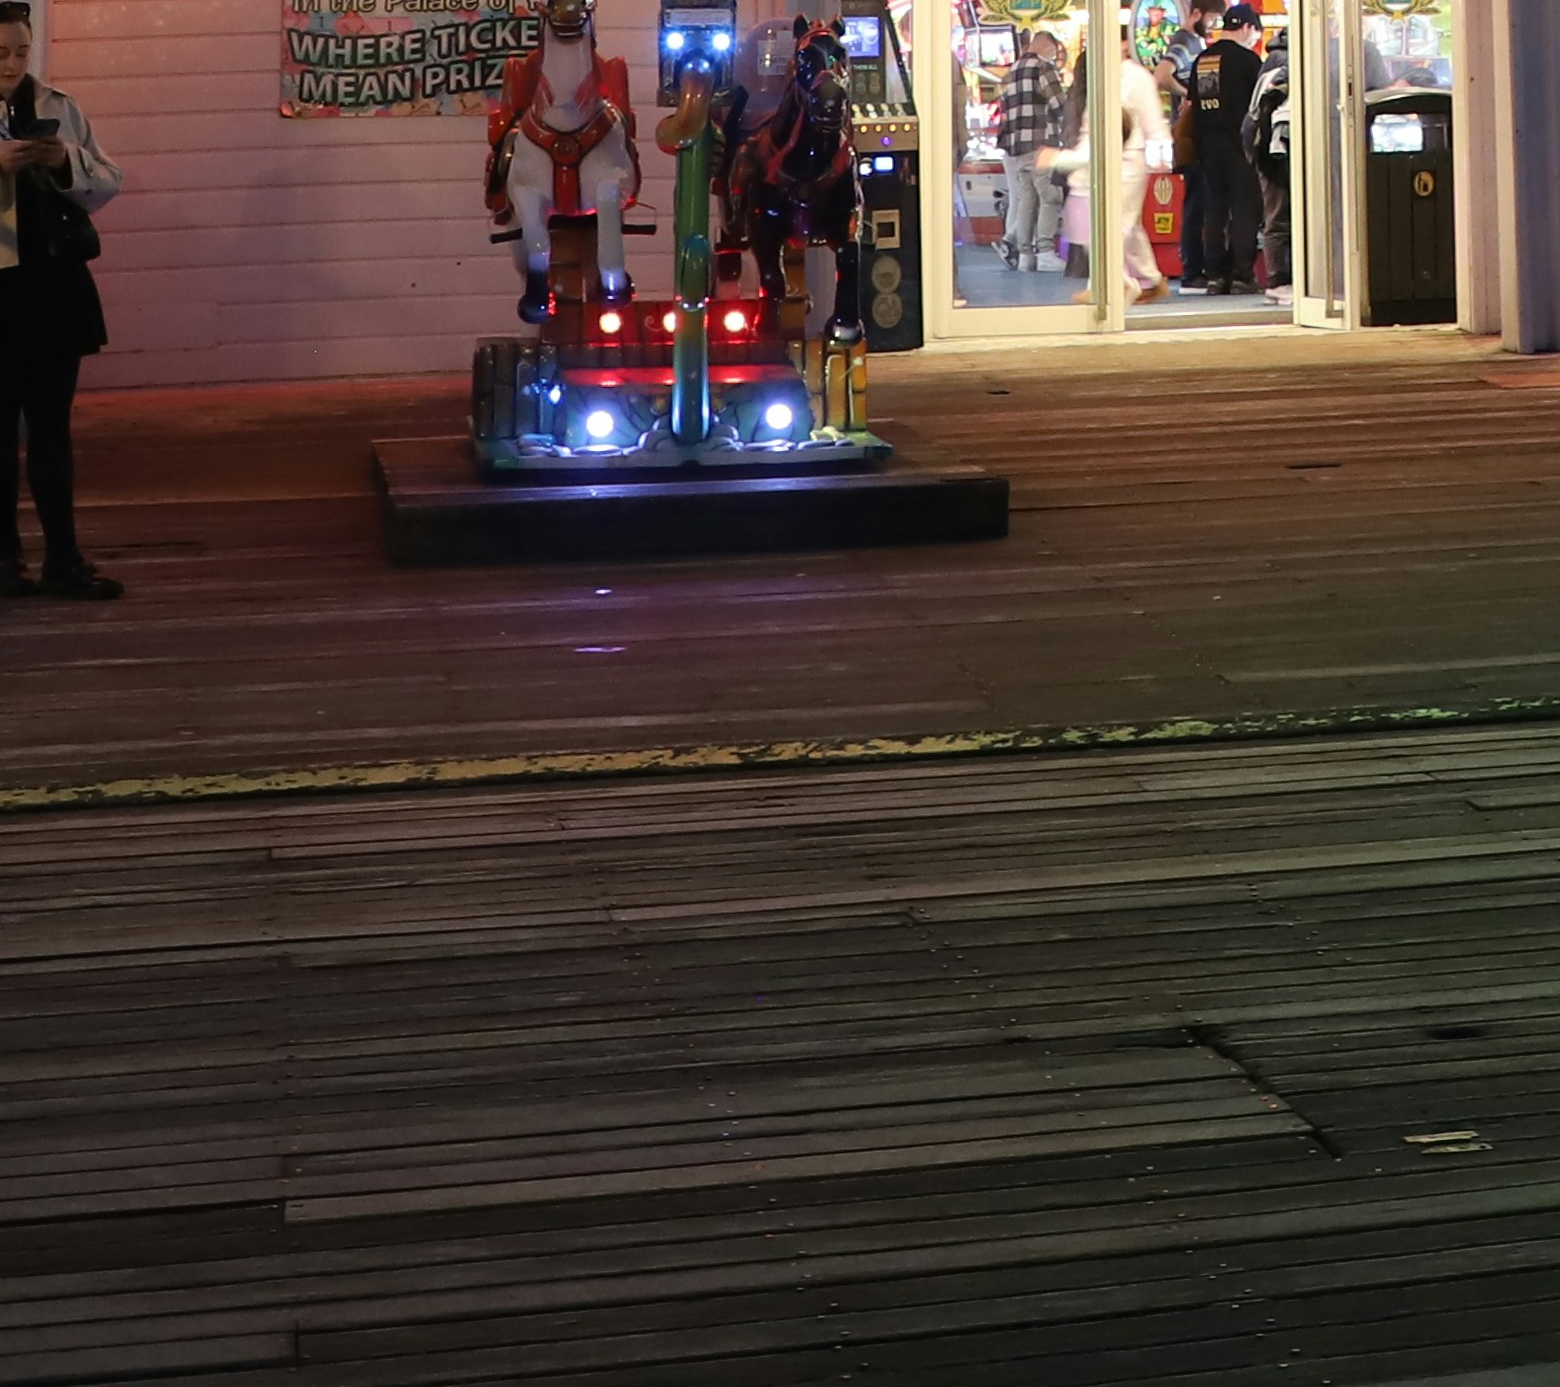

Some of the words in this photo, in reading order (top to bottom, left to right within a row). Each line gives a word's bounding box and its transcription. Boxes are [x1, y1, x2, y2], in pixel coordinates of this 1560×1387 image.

[290, 28, 425, 68] WHERE
[433, 17, 541, 59] TICKE
[299, 67, 415, 107] MEAN
[422, 57, 505, 97] PRIZ
